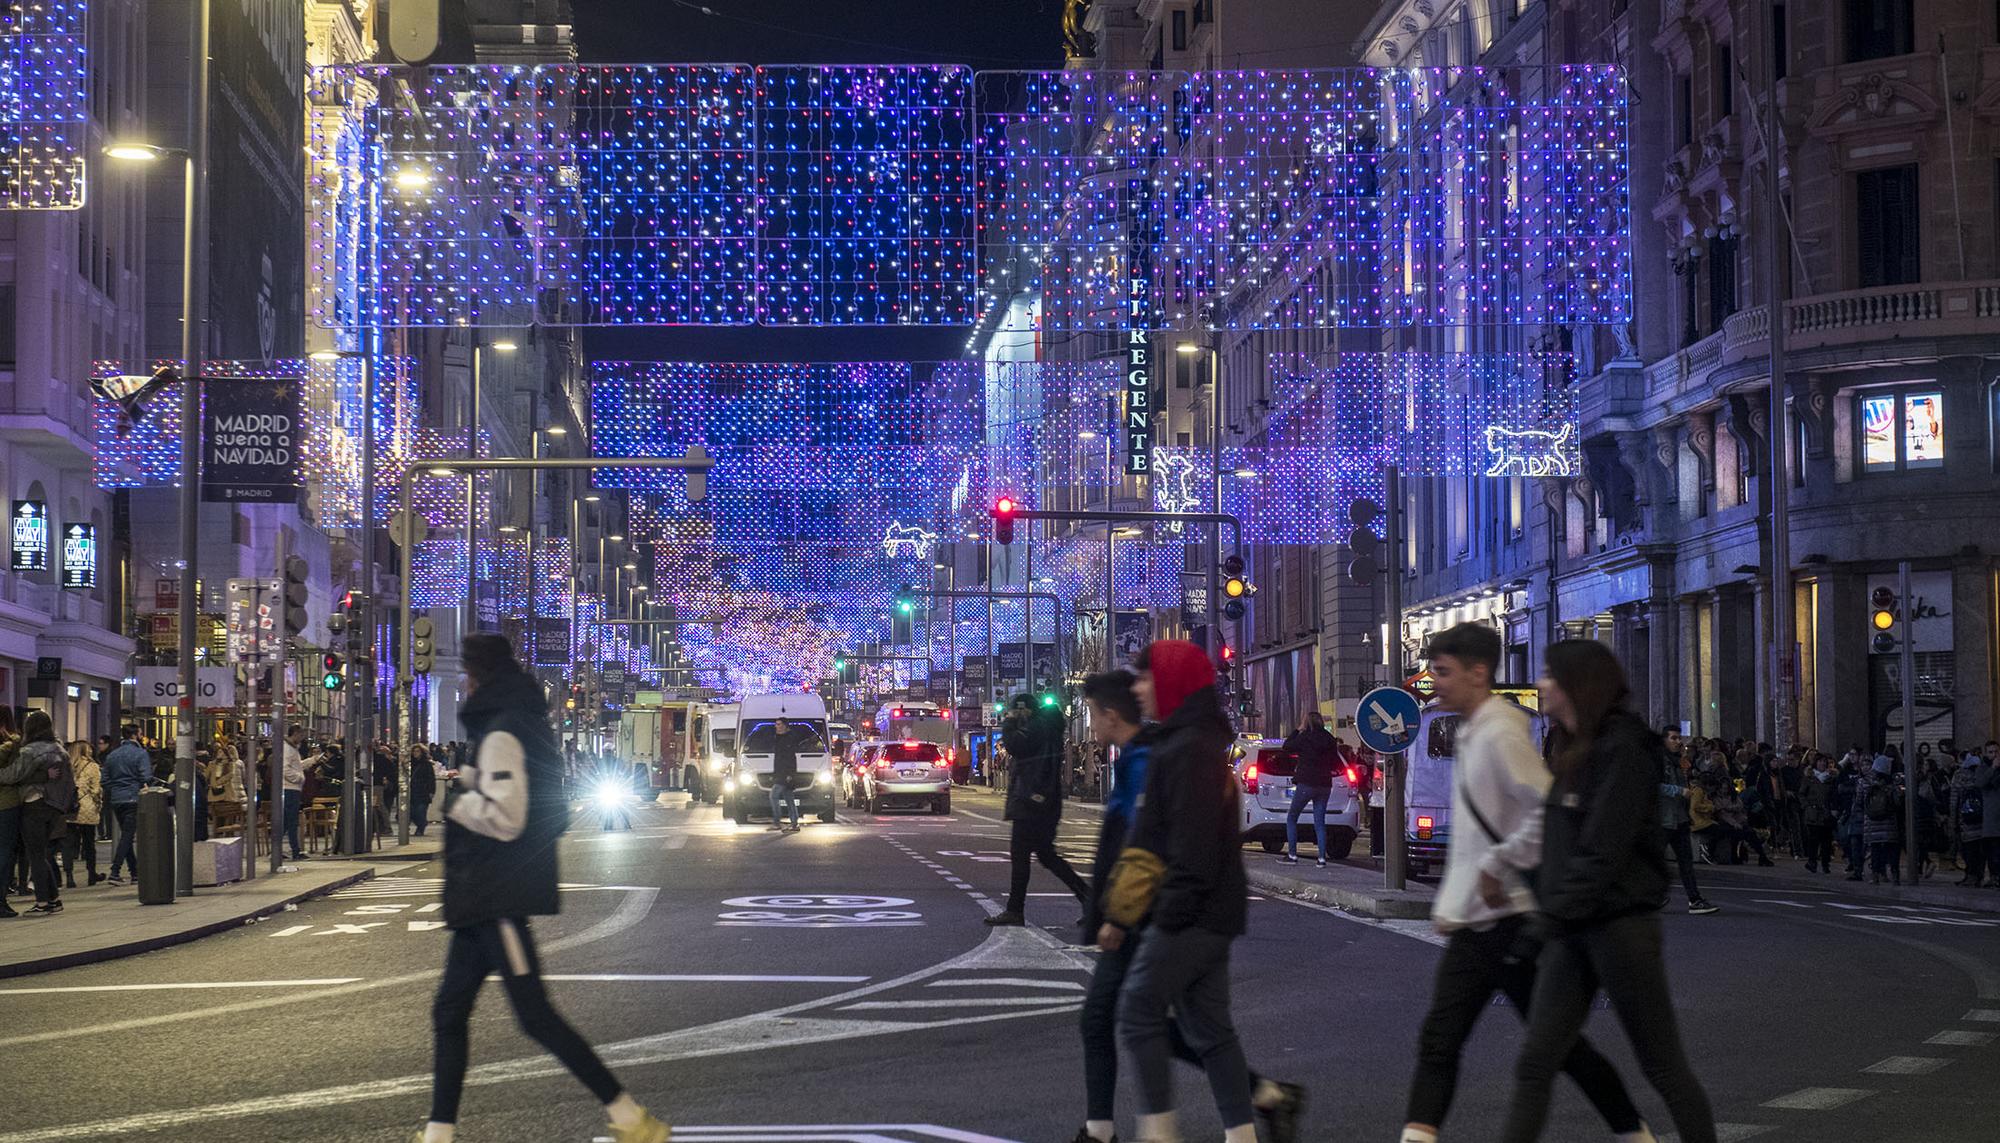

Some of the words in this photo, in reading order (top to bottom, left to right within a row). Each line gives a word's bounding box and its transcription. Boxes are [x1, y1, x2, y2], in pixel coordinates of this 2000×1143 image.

[1128, 328, 1148, 471] REGENTE
[214, 414, 290, 433] MADRID
[214, 434, 272, 446] suena
[277, 435, 290, 447] a
[213, 447, 290, 465] NAVIDAD
[236, 489, 272, 497] MADRID
[14, 528, 40, 541] WAY
[64, 549, 89, 560] WAY
